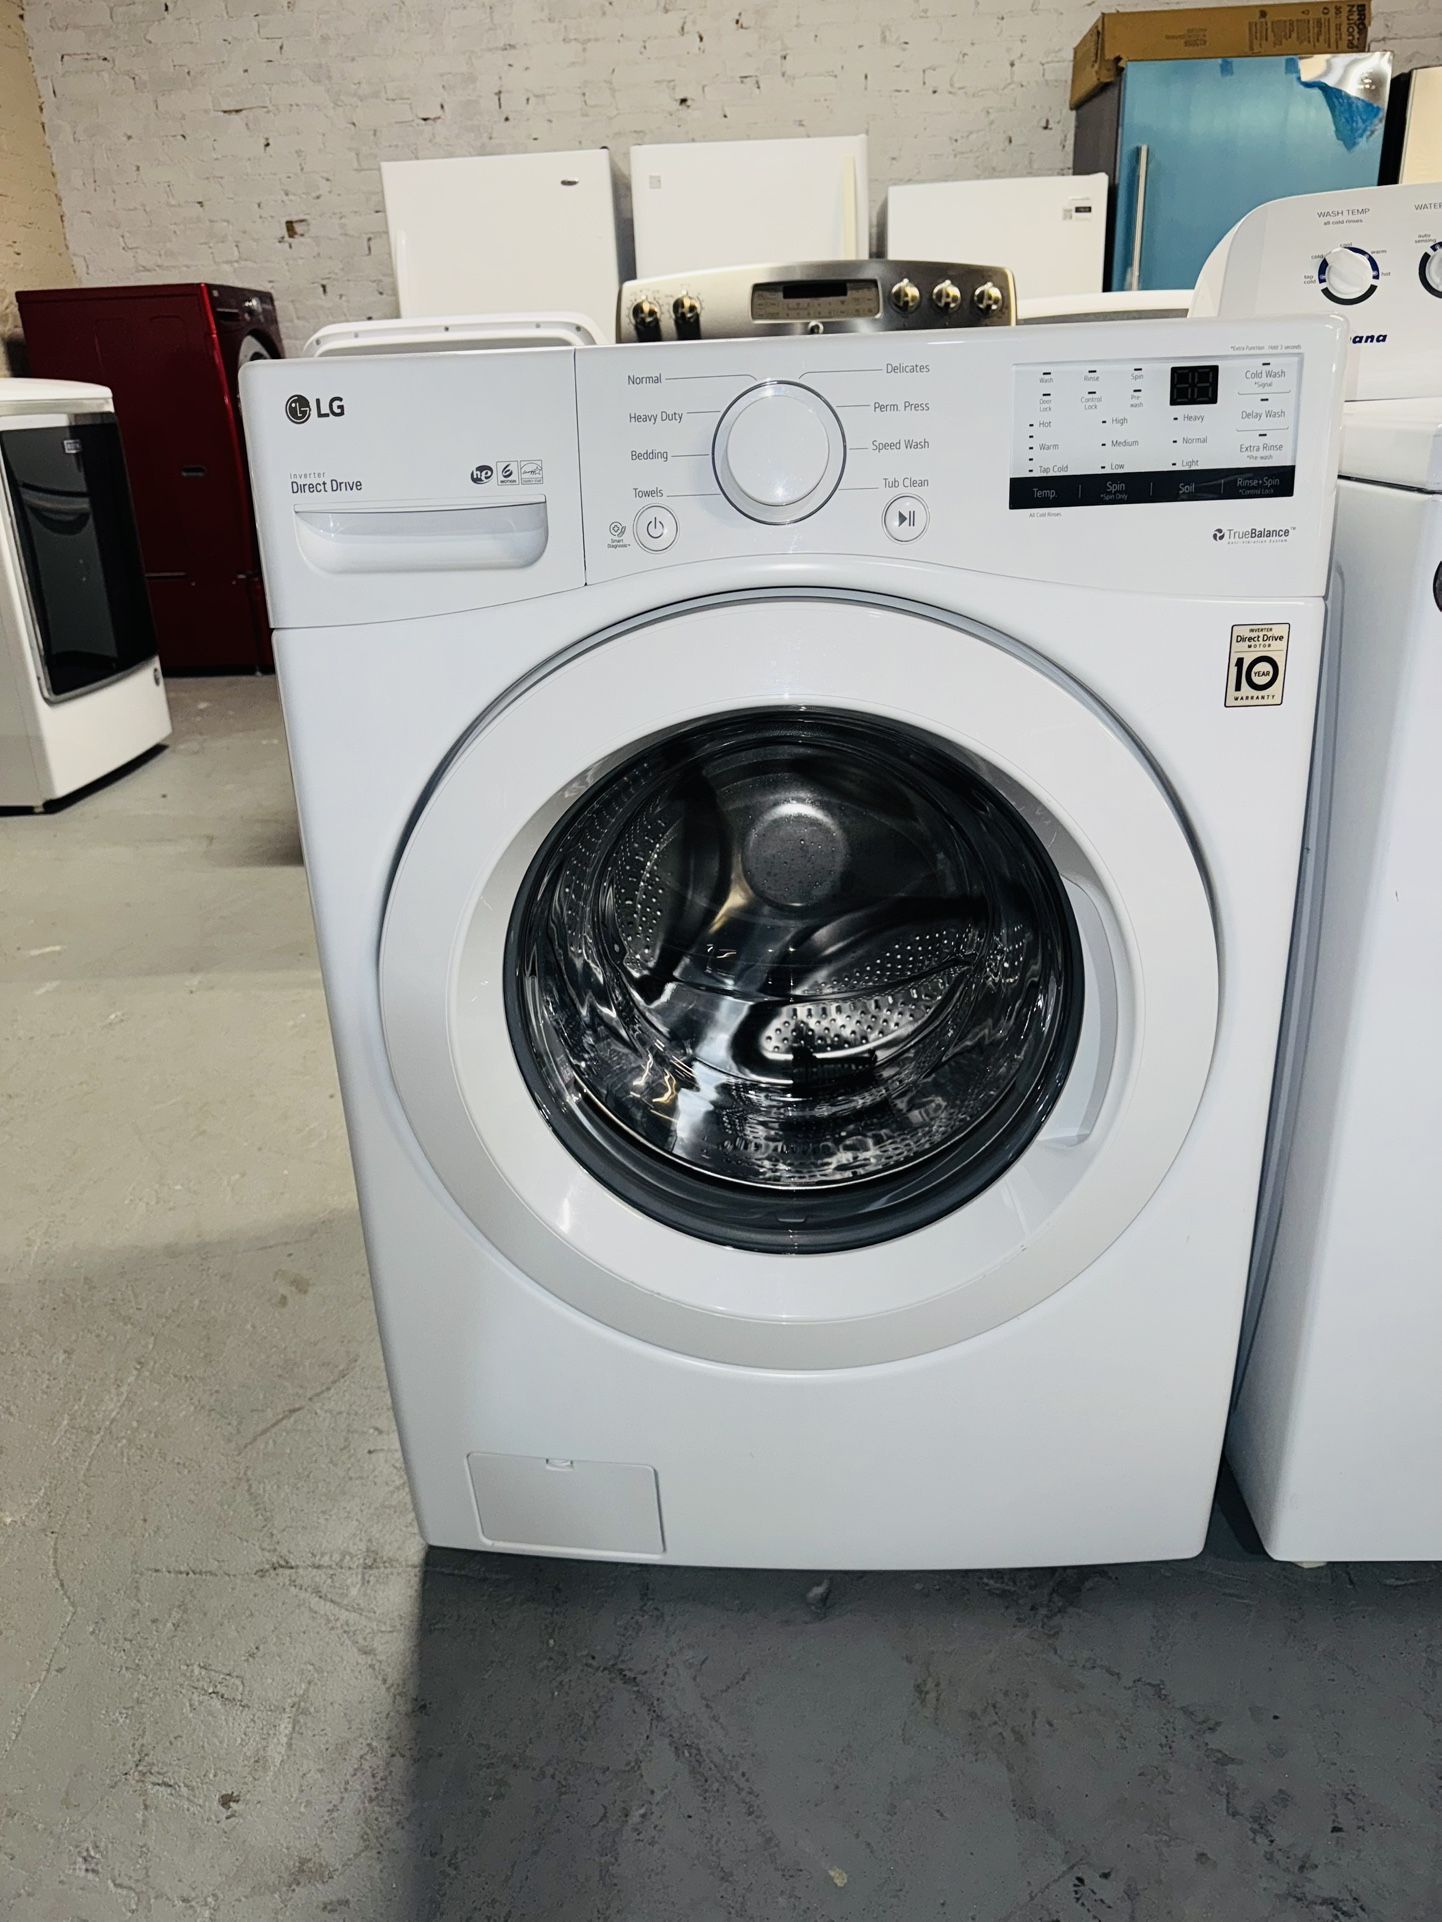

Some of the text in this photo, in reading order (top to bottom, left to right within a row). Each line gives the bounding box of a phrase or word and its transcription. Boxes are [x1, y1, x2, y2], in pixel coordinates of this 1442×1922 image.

[1317, 208, 1371, 218] WASH TEMP
[1350, 333, 1388, 345] ana
[886, 363, 930, 374] Delicates
[1245, 368, 1286, 380] Cold Wash
[627, 373, 662, 386] Normal
[1130, 373, 1144, 382] Spin
[1080, 396, 1103, 404] Control
[316, 396, 345, 419] LG
[873, 400, 930, 413] Perm. Press
[1084, 403, 1098, 411] Lock
[629, 410, 683, 425] Heavy Duty
[1183, 413, 1205, 424] Heavy
[1241, 409, 1286, 421] Delay Wash
[1039, 420, 1052, 428] Hot
[1111, 416, 1128, 426] High
[872, 438, 930, 453] Speed Wash
[1111, 439, 1139, 448] Medium
[1182, 436, 1208, 445] Normal
[1039, 443, 1060, 451] Warm
[1239, 442, 1284, 453] Extra Rinse
[630, 449, 669, 463] Bedding
[1039, 464, 1069, 475] Tap Cold
[1110, 462, 1125, 471] Low
[1181, 459, 1199, 469] Light
[291, 479, 363, 494] Direct Drive
[883, 477, 929, 489] Tub Clean
[1106, 480, 1126, 493] Spin
[1178, 482, 1196, 494] Soil
[633, 486, 664, 499] Towels
[1235, 633, 1285, 643] Direct Drive
[1234, 655, 1279, 692] 10
[1253, 670, 1271, 678] YEAR
